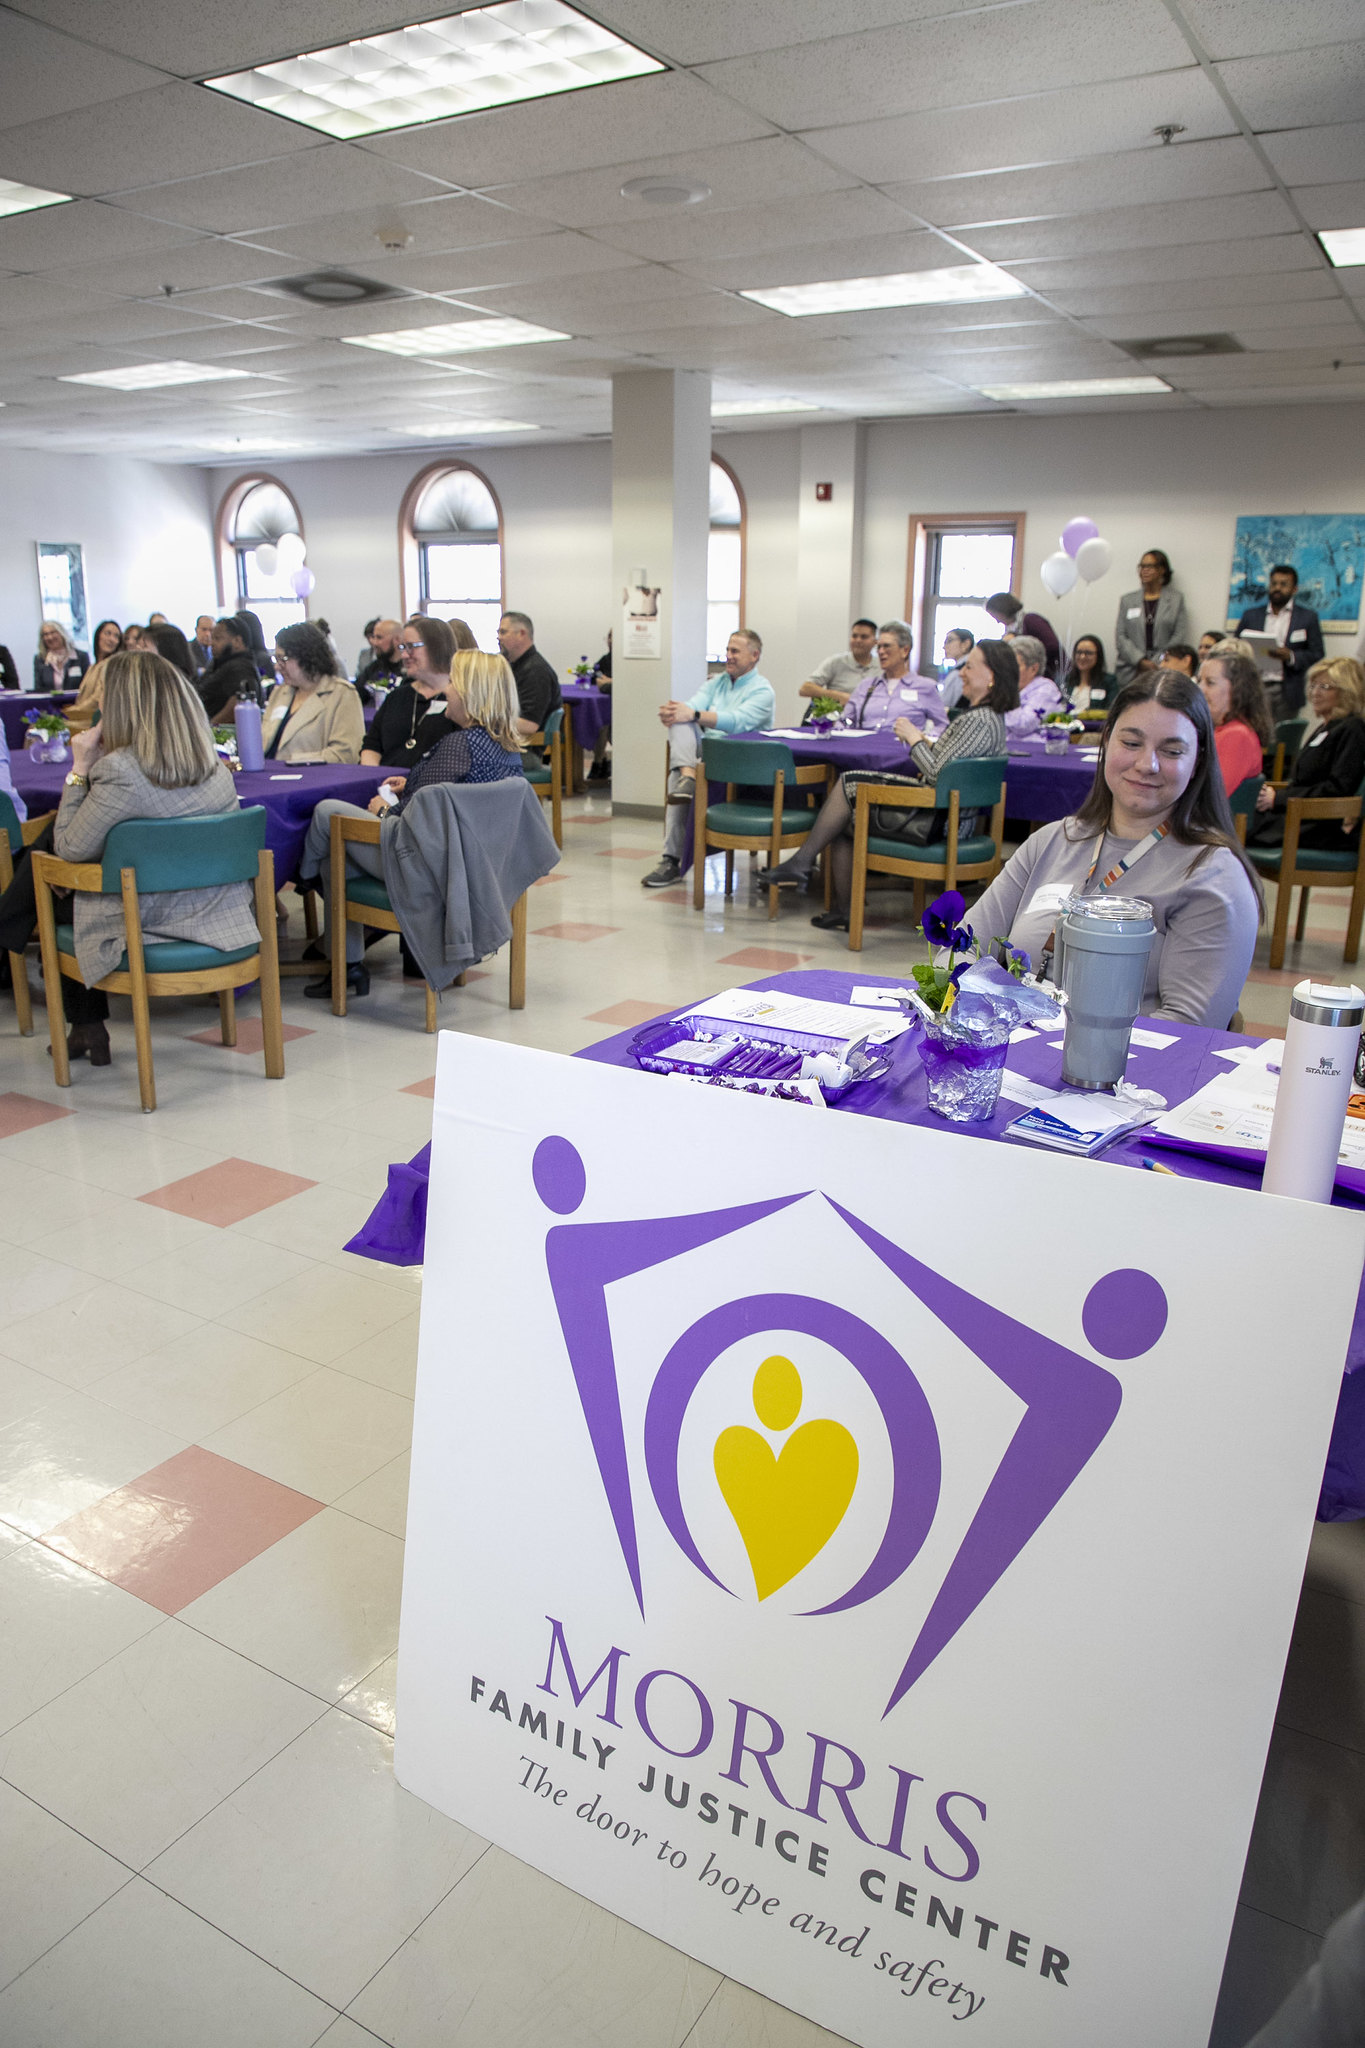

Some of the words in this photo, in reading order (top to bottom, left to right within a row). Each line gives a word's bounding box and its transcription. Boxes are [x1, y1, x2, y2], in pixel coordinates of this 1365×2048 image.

[1305, 1067, 1341, 1076] STANLEY
[470, 1675, 617, 1771] FAMILY
[637, 1764, 830, 1878] JUSTICE
[859, 1868, 1070, 1988] CENTER
[535, 1615, 987, 1883] MORRIS
[518, 1755, 569, 1806] The
[575, 1793, 649, 1847] door
[656, 1840, 688, 1869] to
[698, 1851, 781, 1916] hope
[789, 1912, 871, 1964] and
[873, 1951, 986, 2021] safety
